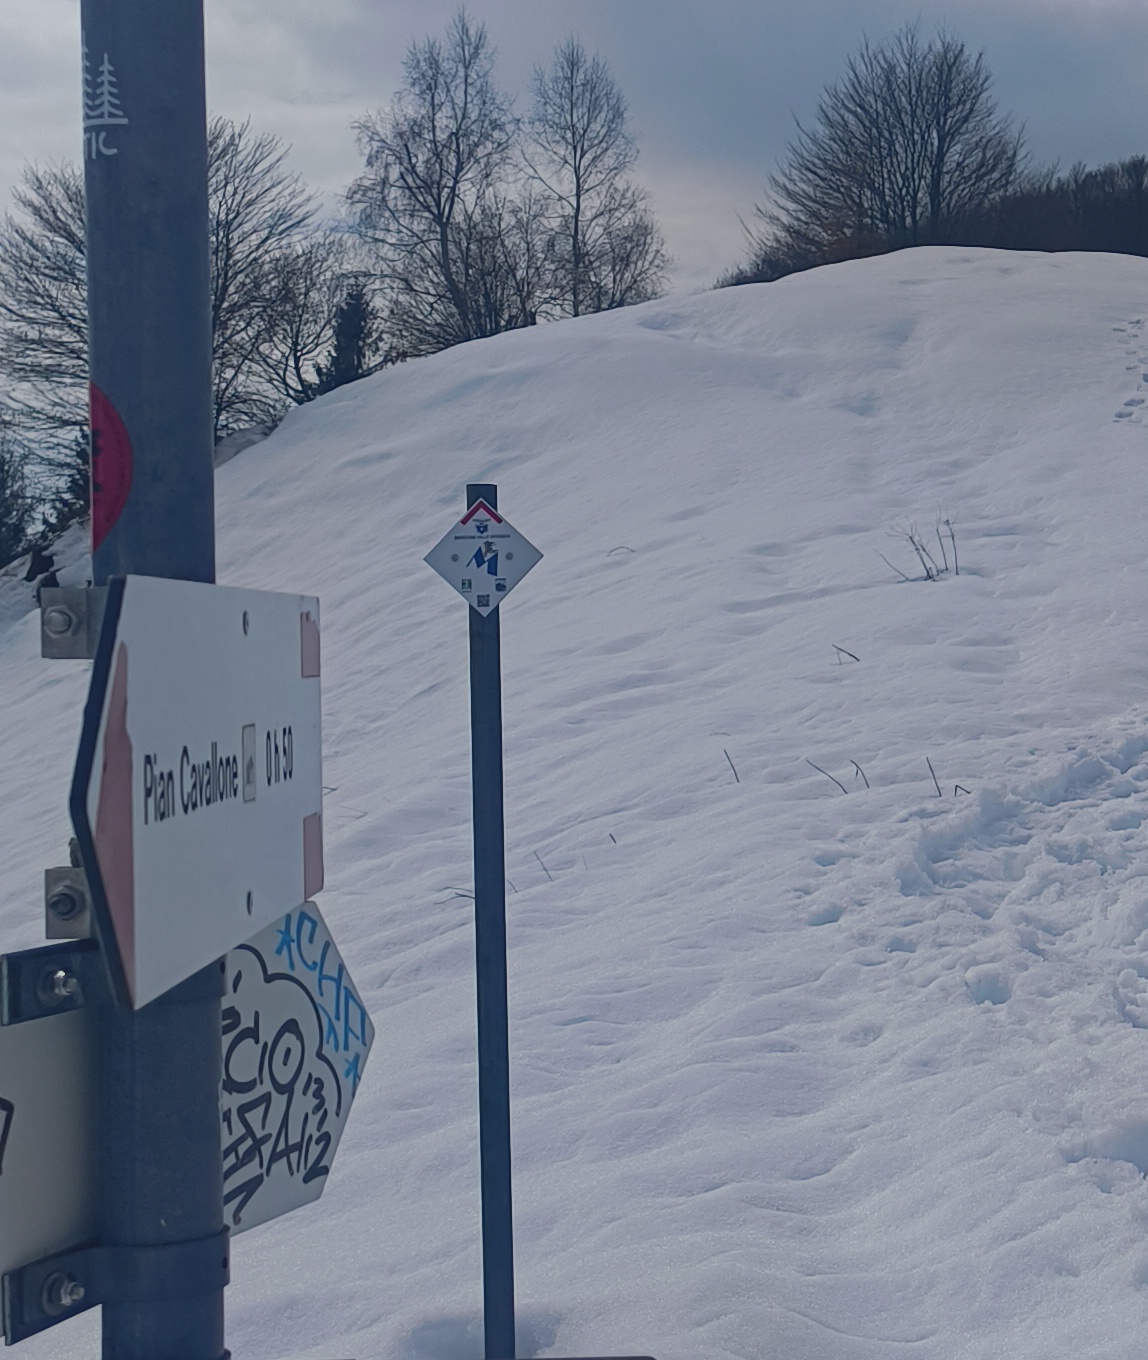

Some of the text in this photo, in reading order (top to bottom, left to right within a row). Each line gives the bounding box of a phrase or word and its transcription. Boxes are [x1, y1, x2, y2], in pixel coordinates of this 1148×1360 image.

[144, 725, 293, 825] Pian Cavallone 0 h 50
